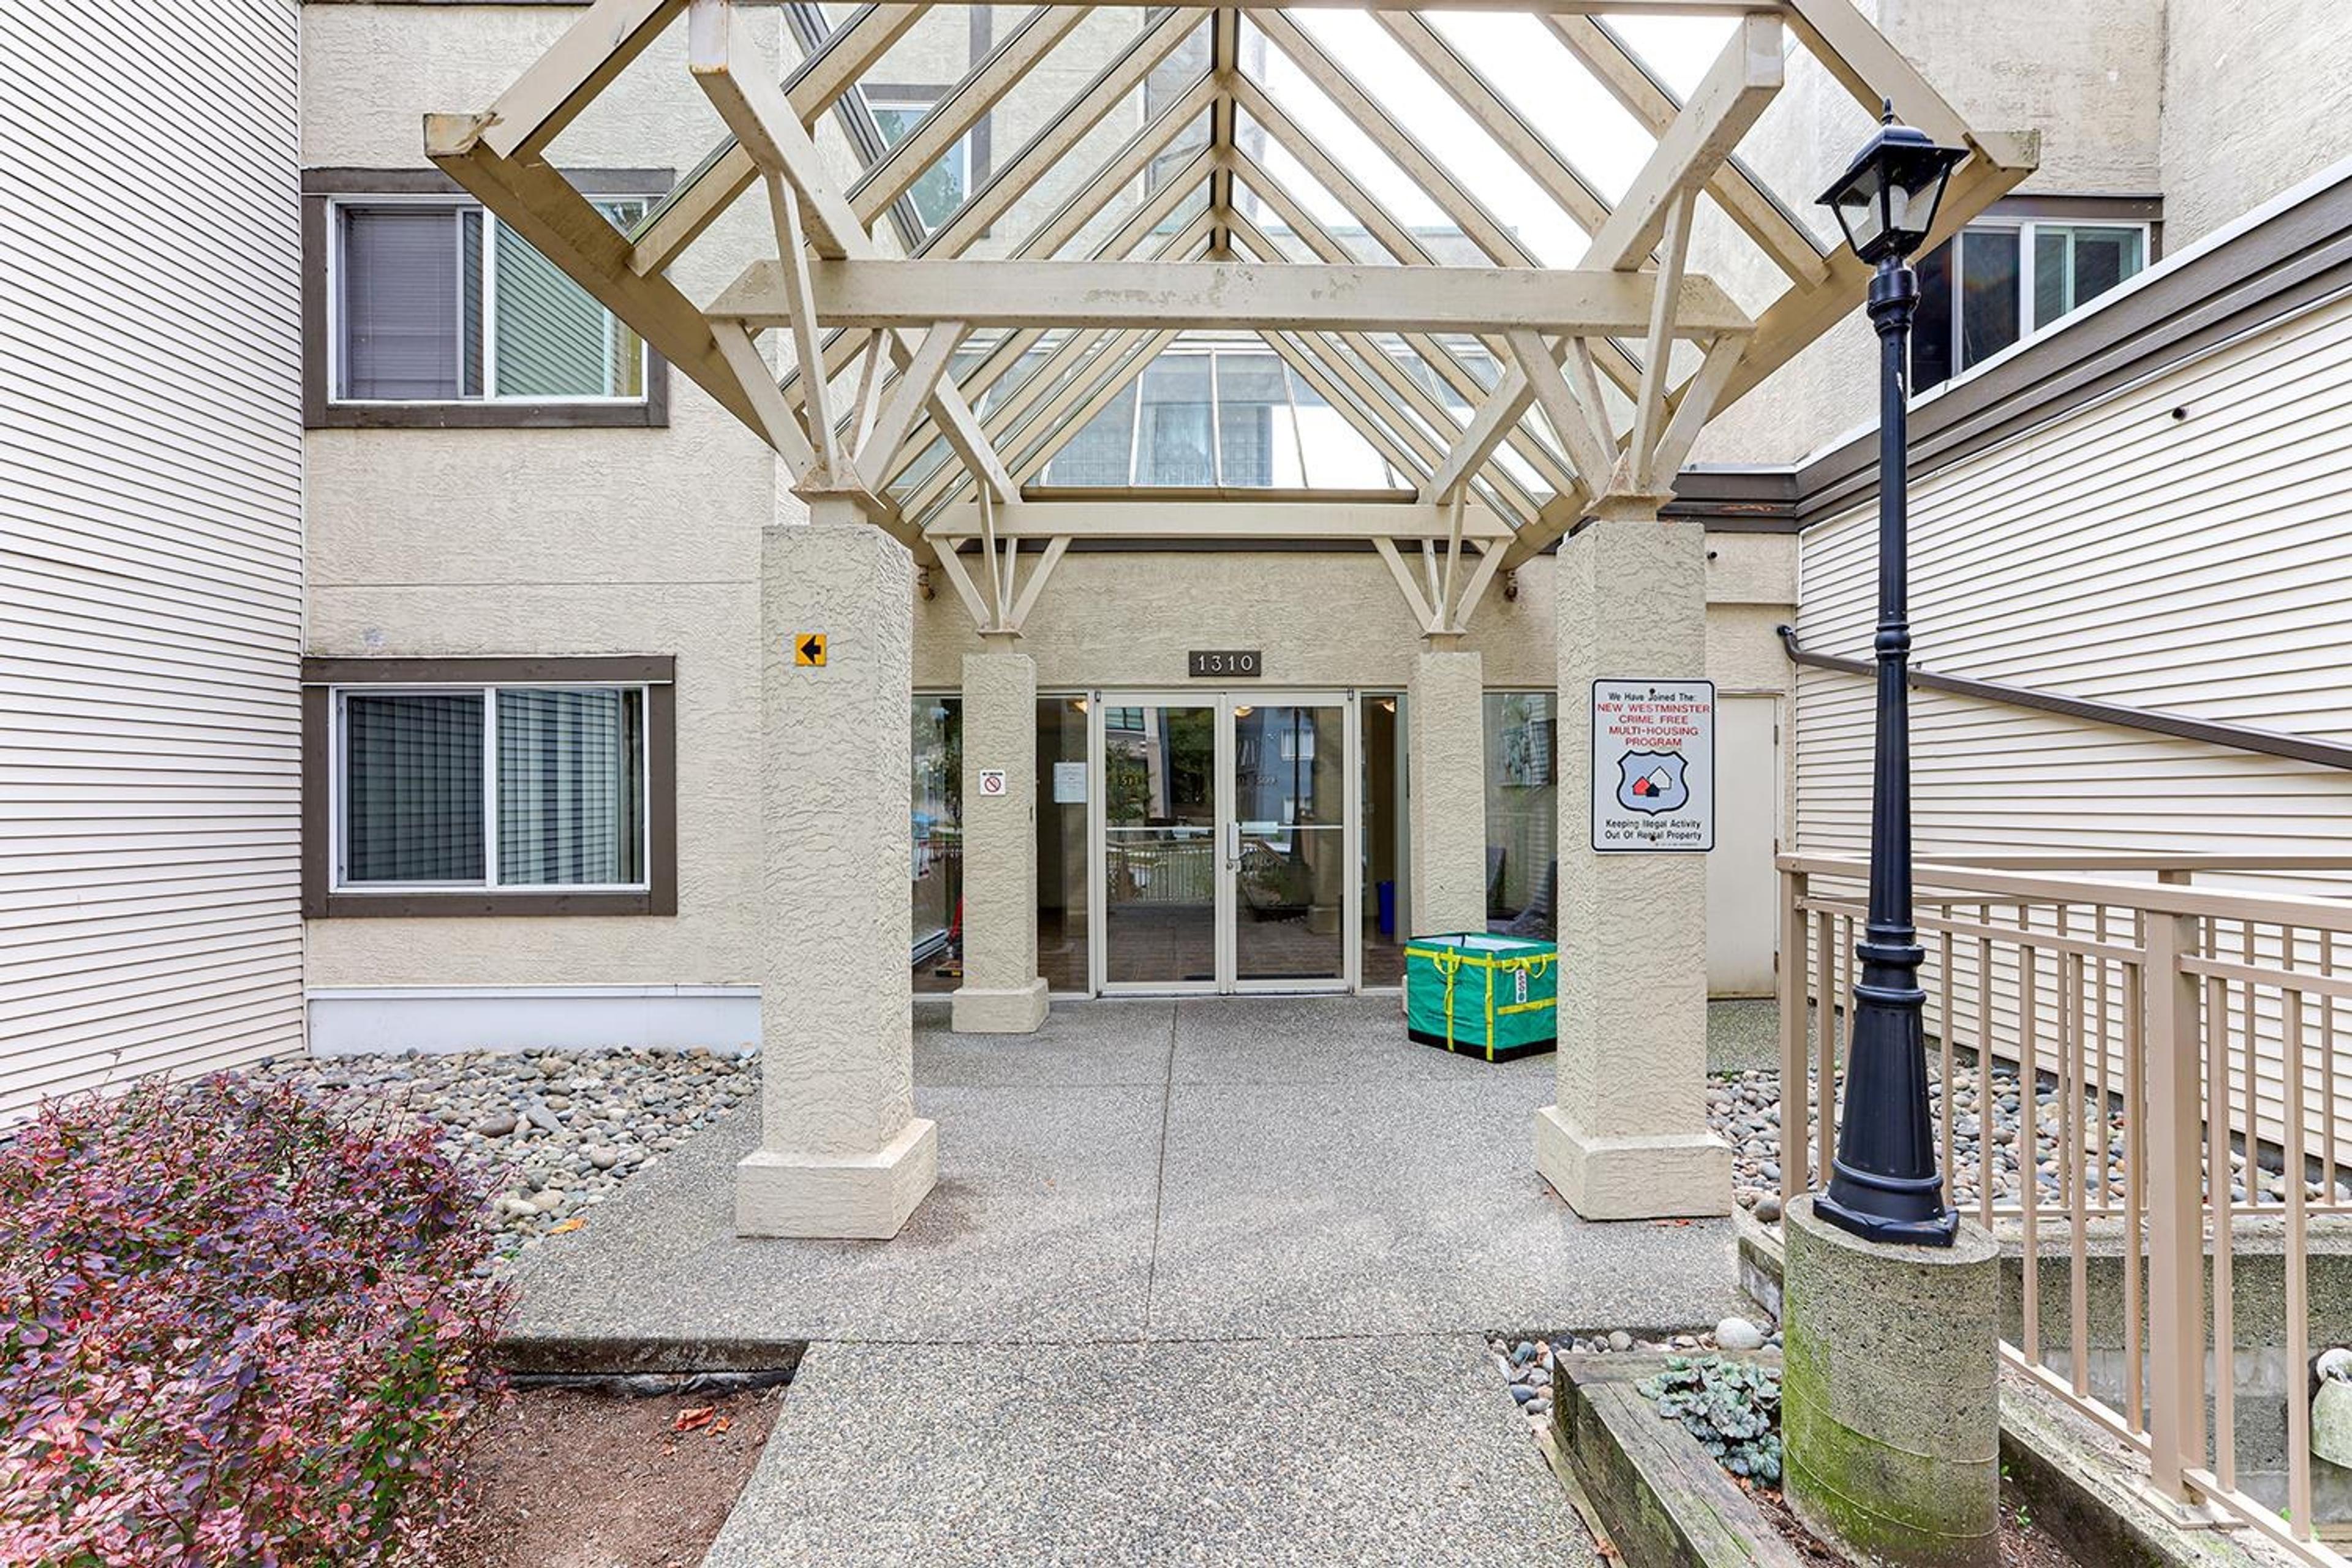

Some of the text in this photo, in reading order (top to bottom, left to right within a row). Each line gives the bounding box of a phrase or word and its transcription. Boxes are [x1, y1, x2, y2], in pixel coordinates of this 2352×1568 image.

[1199, 655, 1253, 671] 1310
[1648, 692, 1675, 701] Joined
[1597, 704, 1710, 713] NEW WESTMINSTER
[1618, 715, 1689, 724] CRIME FREE
[1609, 726, 1698, 735] MULTI-HOUSING
[1626, 737, 1682, 746] PROGRAM
[1605, 819, 1702, 829] Keeping Illegal Activity
[1605, 830, 1620, 839] Out
[1624, 830, 1634, 839] Of
[1667, 831, 1702, 840] Property
